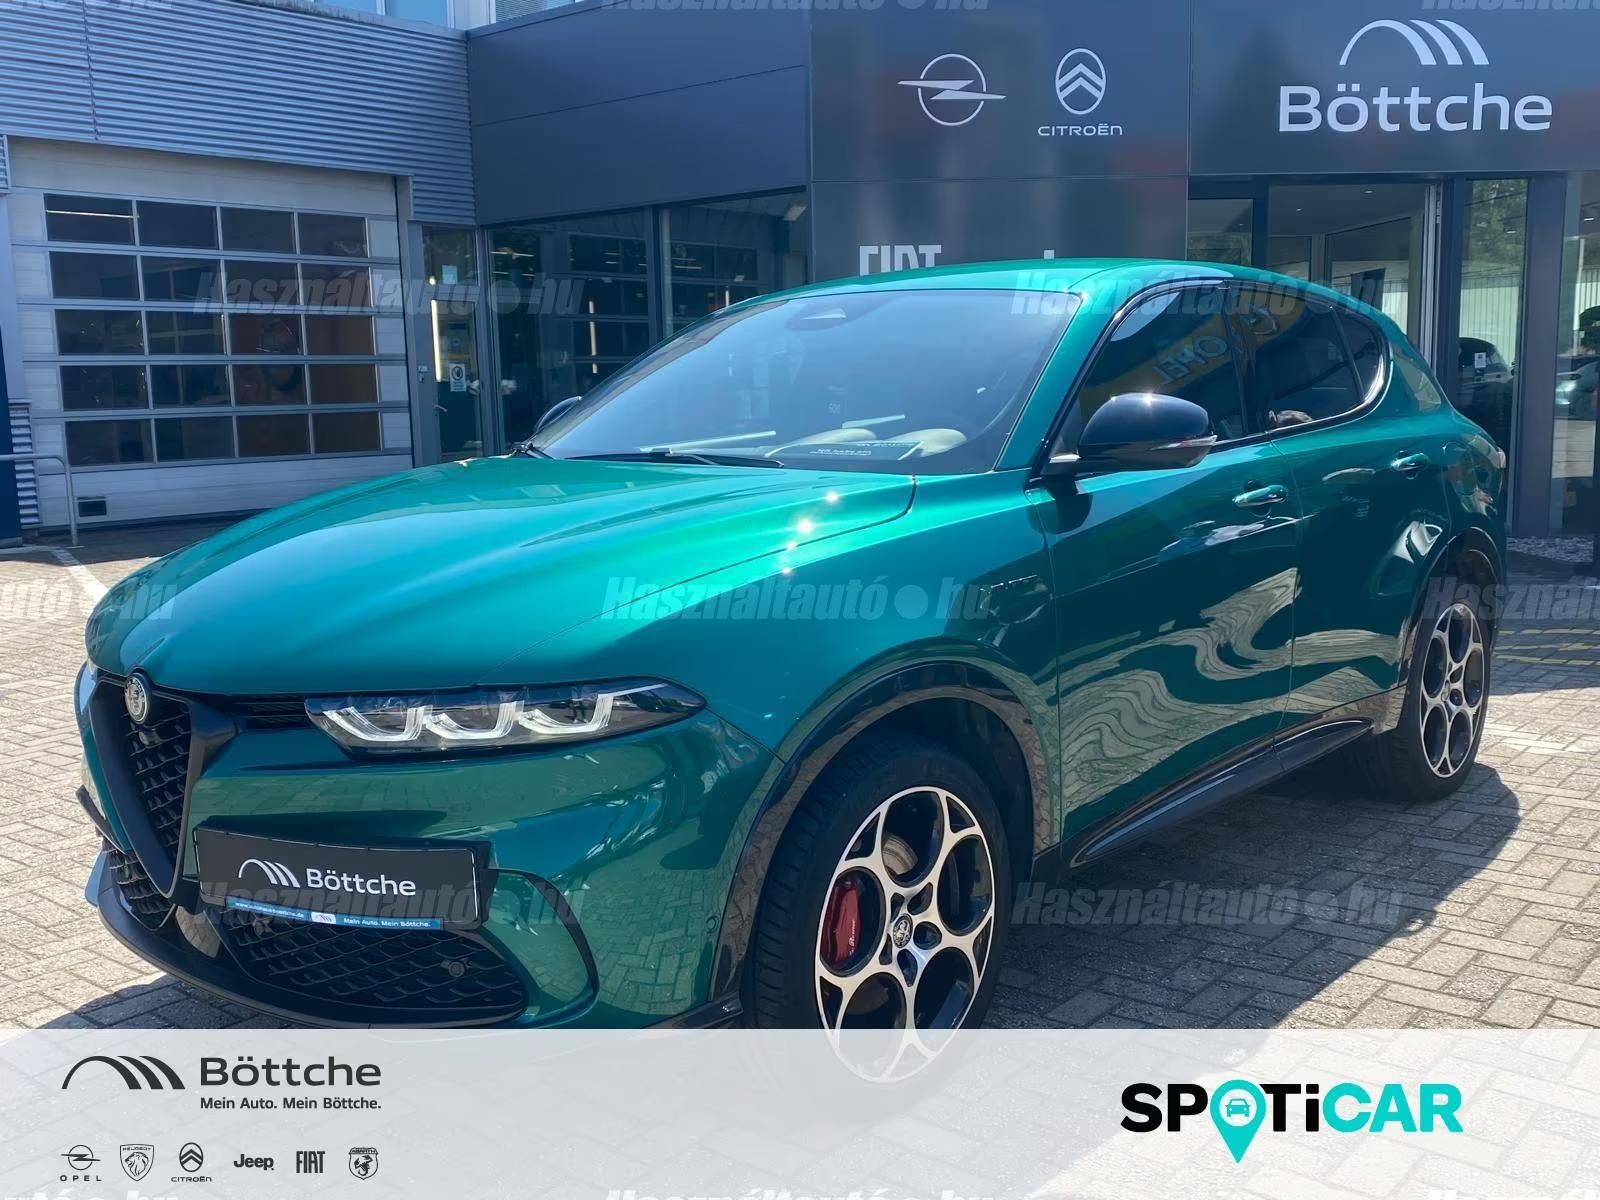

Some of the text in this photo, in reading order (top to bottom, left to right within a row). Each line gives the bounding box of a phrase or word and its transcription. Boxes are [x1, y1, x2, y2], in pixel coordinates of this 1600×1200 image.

[1278, 83, 1553, 132] Böttche
[1037, 123, 1123, 136] CITROËN
[306, 868, 416, 896] Böttche
[343, 917, 360, 925] Mein
[381, 919, 399, 927] Mein
